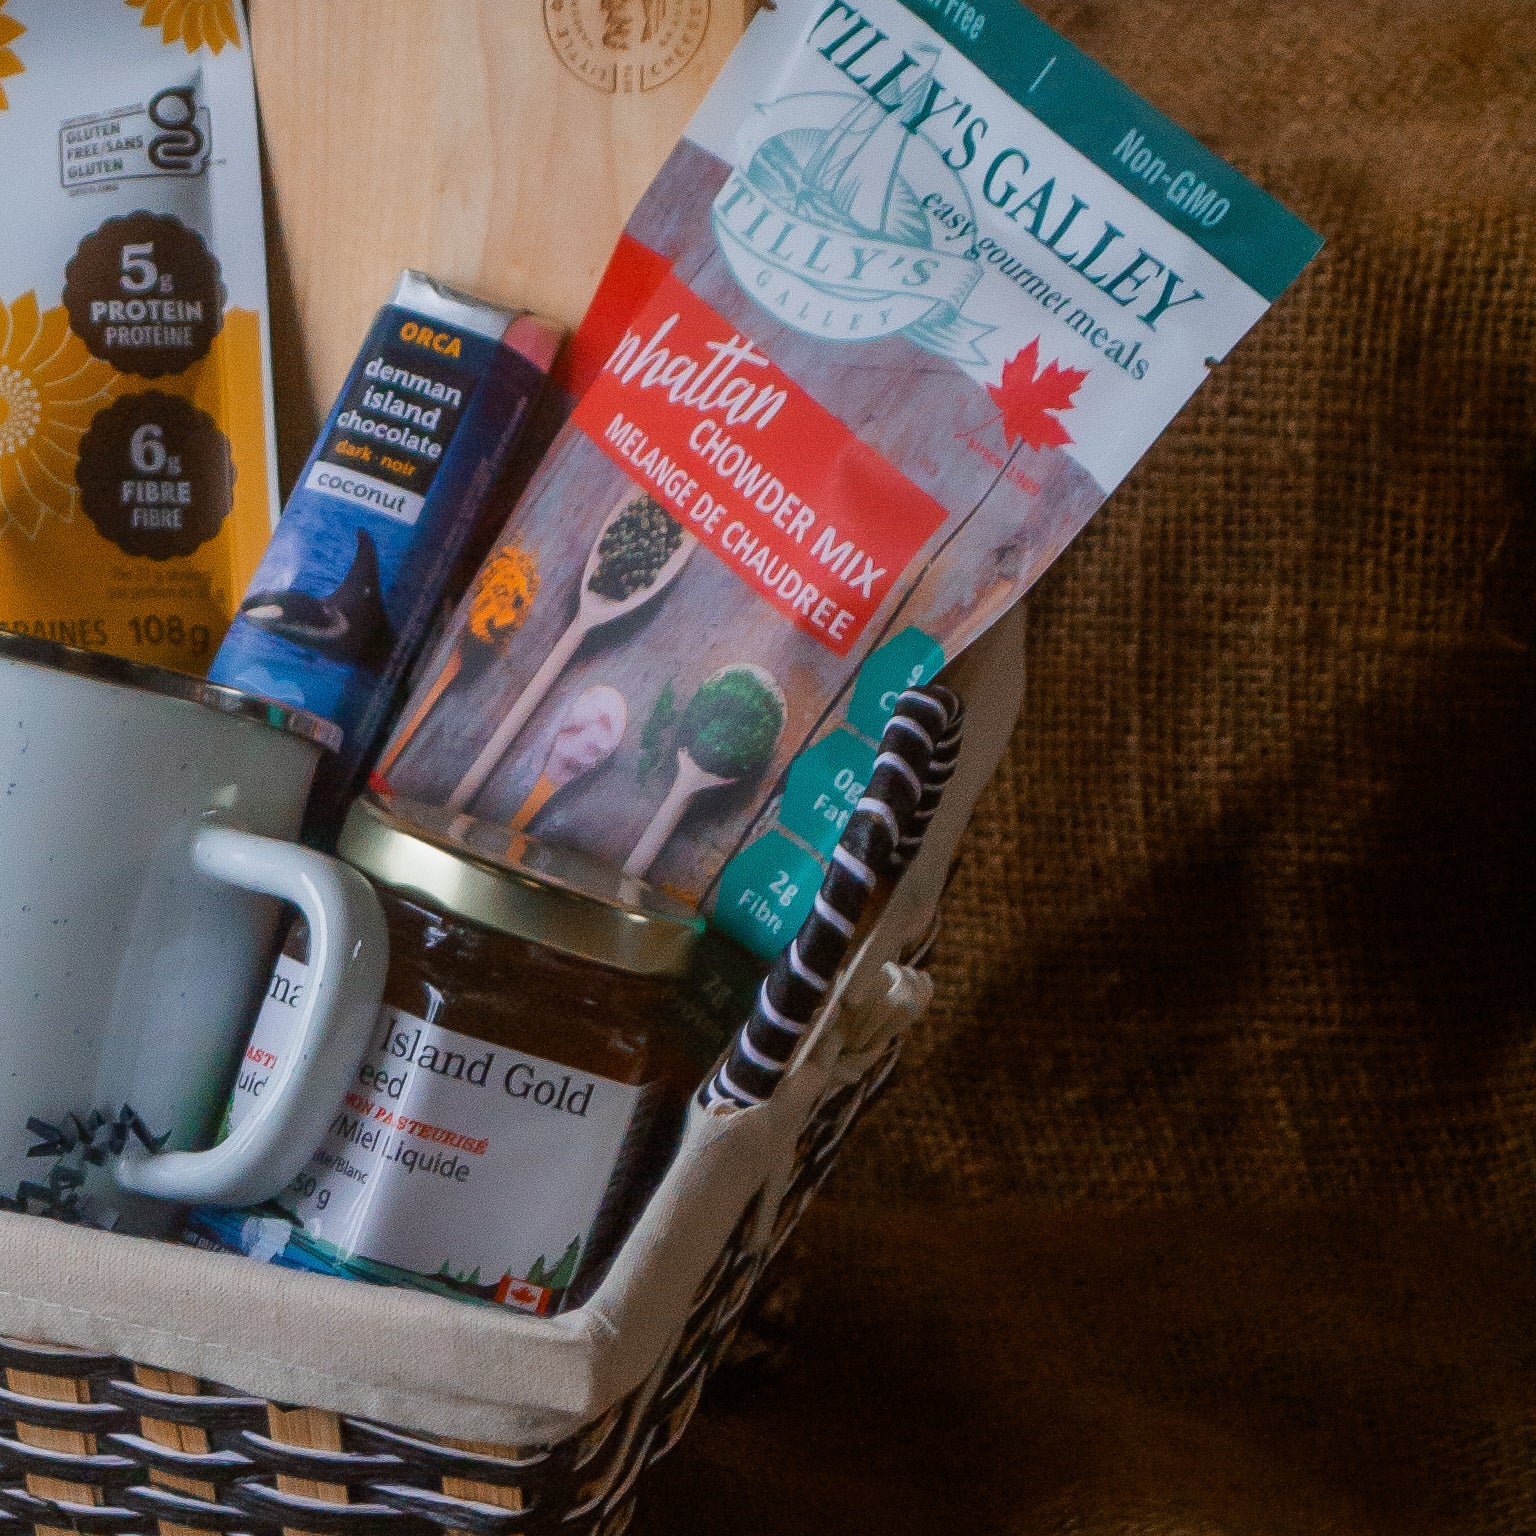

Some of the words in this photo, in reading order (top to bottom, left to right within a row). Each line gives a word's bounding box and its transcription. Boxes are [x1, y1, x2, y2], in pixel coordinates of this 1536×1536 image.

[66, 122, 121, 144] GLUTEN
[67, 158, 124, 179] GLUTEN
[1113, 128, 1231, 228] Non-GMO
[720, 175, 940, 287] TILLY'S
[982, 146, 1205, 333] GALLEY
[920, 189, 978, 243] easy
[964, 235, 1071, 316] gourmet
[1065, 307, 1150, 382] meals
[89, 299, 203, 323] PROTEIN
[400, 321, 463, 359] ORCA
[365, 357, 462, 408] denman
[362, 385, 442, 431] island
[335, 439, 373, 462] dark
[380, 455, 416, 476] noir
[337, 410, 443, 460] chocolate
[120, 480, 192, 505] FIBRE
[317, 470, 408, 514] coconut
[688, 418, 816, 544] CHOWDER
[810, 525, 887, 600] MIX
[130, 507, 184, 530] FIBRE
[604, 413, 699, 507] MELANGE
[689, 492, 728, 535] DE
[721, 520, 855, 640] CHAUDREE
[382, 1018, 496, 1088] Island
[504, 1062, 596, 1117] Gold
[380, 1135, 470, 1183] Liquide
